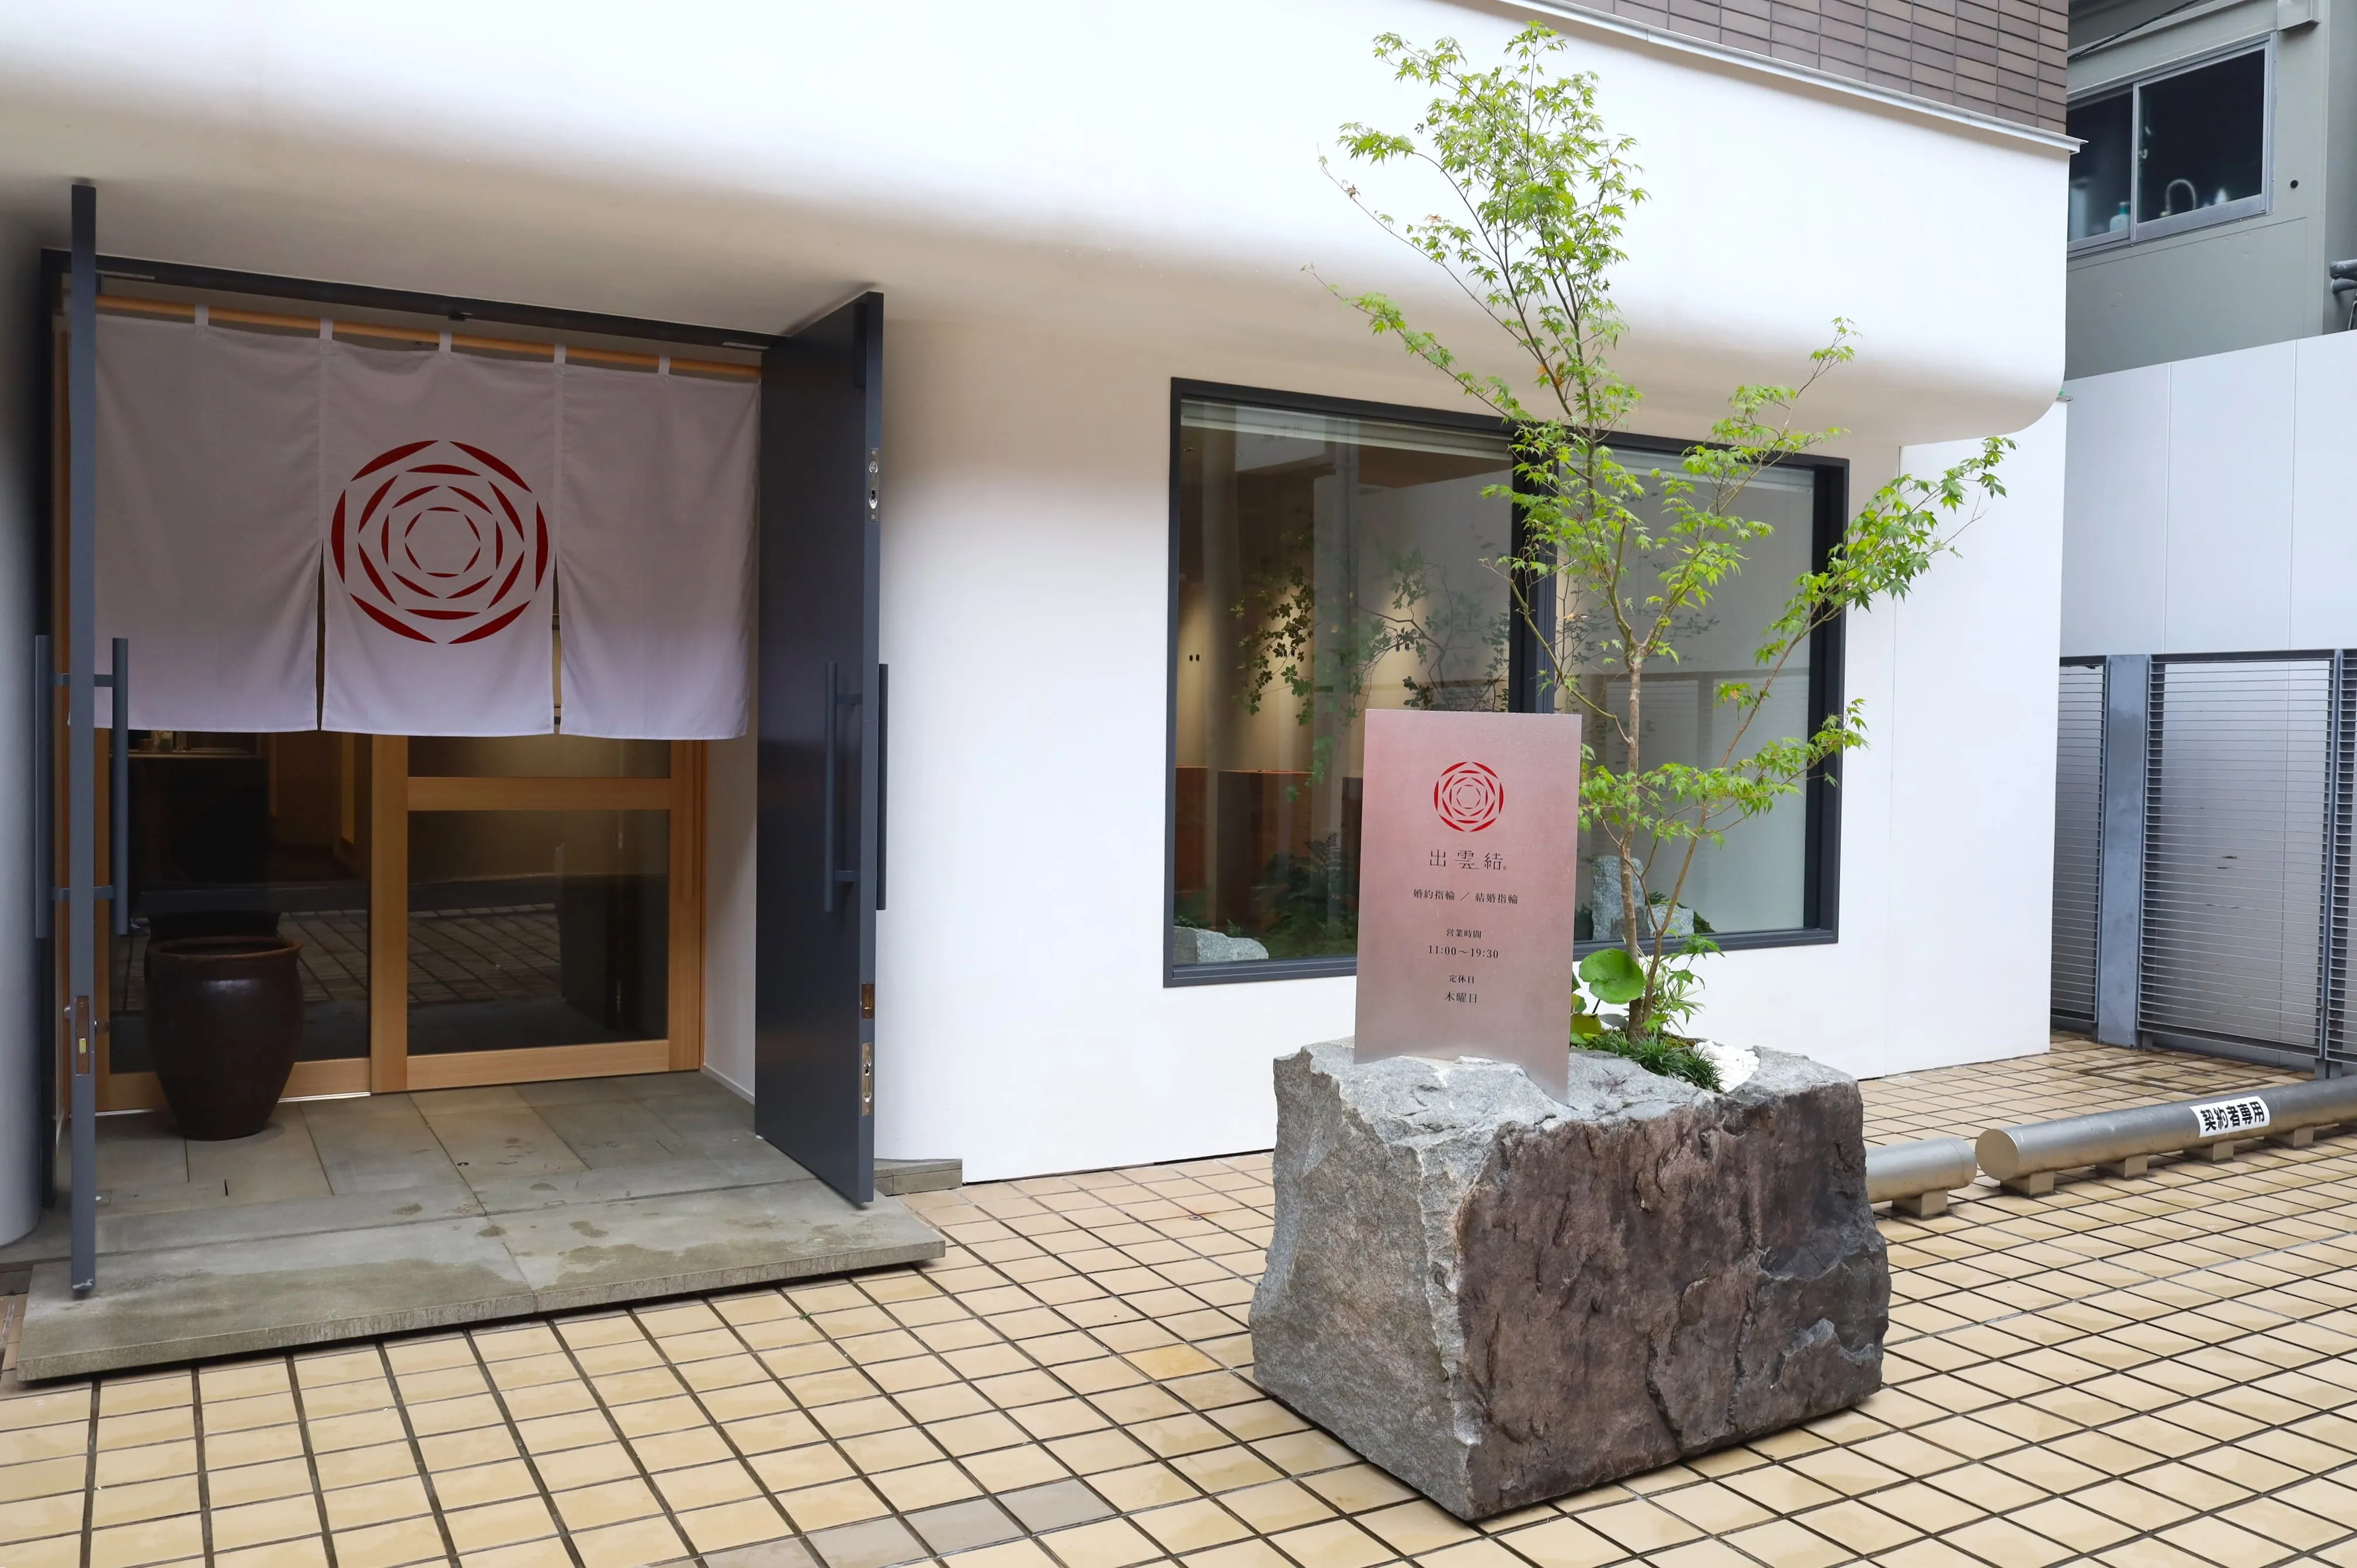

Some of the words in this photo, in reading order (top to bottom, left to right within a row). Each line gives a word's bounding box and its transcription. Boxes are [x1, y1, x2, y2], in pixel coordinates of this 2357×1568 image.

[1413, 888, 1455, 901] 婚約指輪
[1475, 892, 1518, 905] 結婚指輪
[1446, 928, 1482, 939] 営業時間
[1449, 974, 1474, 984] 定休日
[1445, 991, 1477, 1003] 木曜日
[2200, 1101, 2265, 1132] 契約者専用
